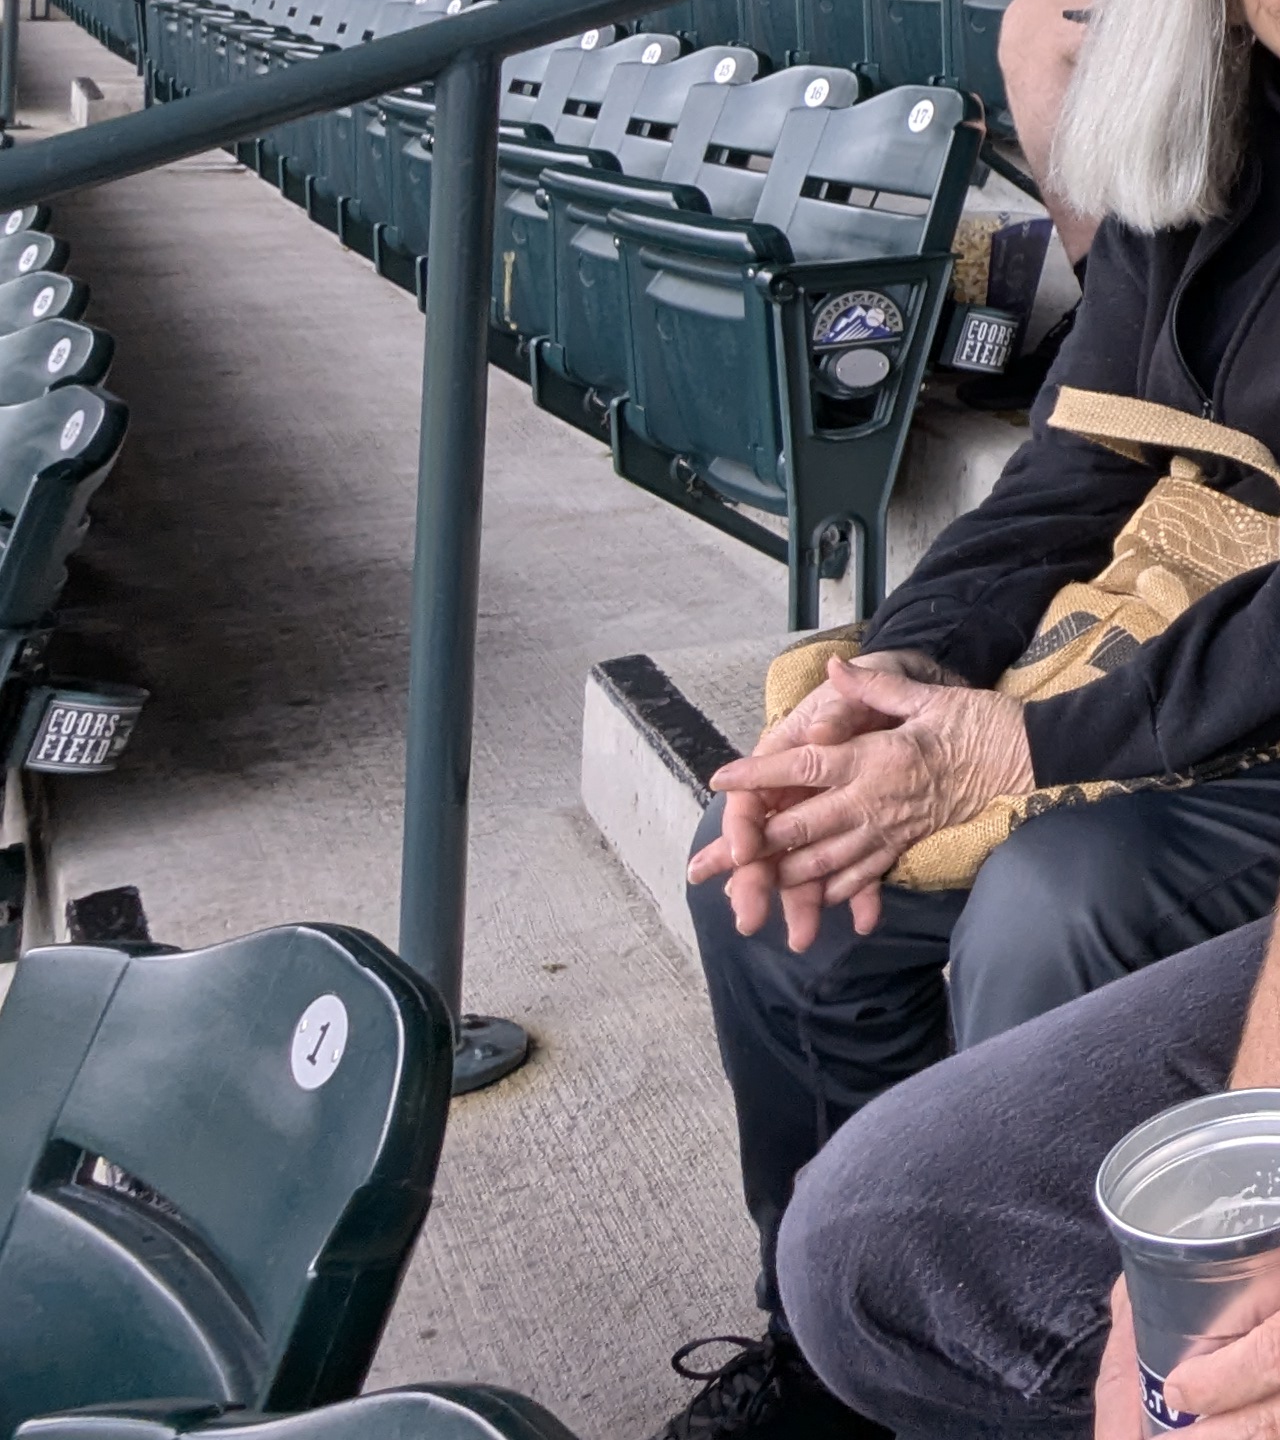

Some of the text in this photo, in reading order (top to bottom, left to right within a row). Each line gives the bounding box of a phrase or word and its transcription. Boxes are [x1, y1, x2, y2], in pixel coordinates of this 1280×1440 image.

[967, 319, 1014, 346] COORS
[960, 339, 1008, 367] FIELD
[47, 708, 120, 738] COORS
[36, 733, 112, 765] FIELD
[305, 1021, 332, 1067] 1
